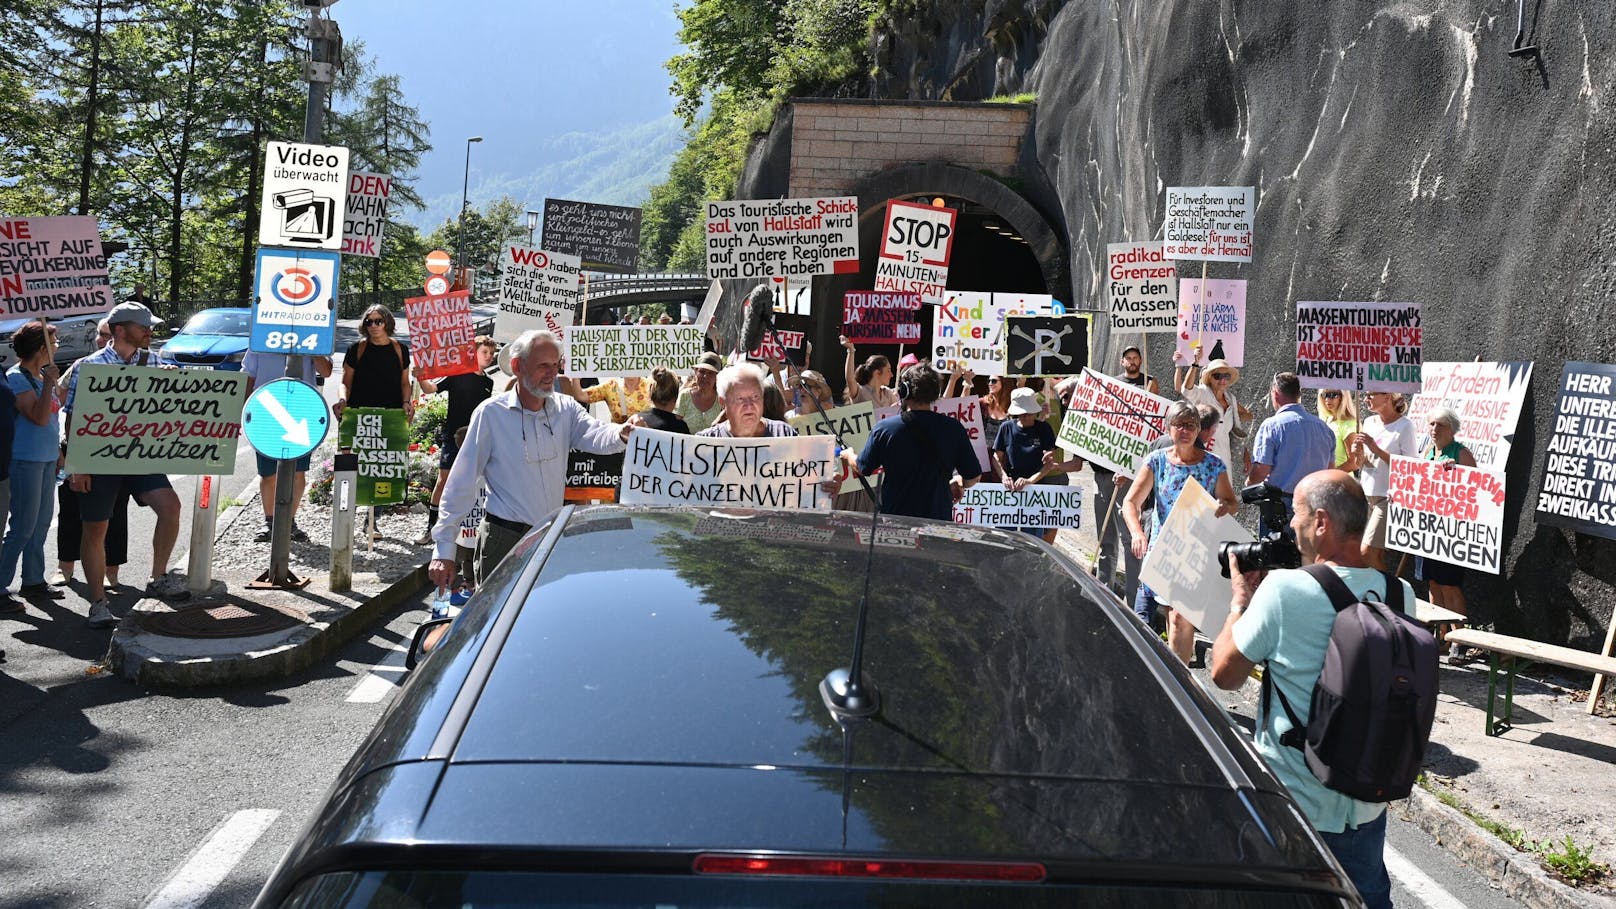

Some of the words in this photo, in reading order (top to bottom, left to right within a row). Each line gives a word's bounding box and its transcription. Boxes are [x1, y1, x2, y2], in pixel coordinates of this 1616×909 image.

[277, 146, 339, 168] Video
[273, 166, 339, 182] überwacht
[350, 174, 391, 198] DEN
[1184, 192, 1224, 205] Investoren
[1227, 193, 1245, 205] und
[709, 204, 735, 218] Das
[740, 201, 812, 218] touristische
[816, 200, 858, 215] Schick-
[1168, 205, 1246, 218] Geschäftemacher
[708, 218, 731, 233] sal
[734, 221, 759, 233] von
[764, 215, 822, 232] Hallstatt
[825, 214, 854, 229] wird
[889, 217, 951, 249] STOP
[1179, 217, 1216, 230] Hallstatt
[1216, 222, 1231, 230] nur
[1233, 219, 1249, 230] ein
[709, 234, 742, 249] auch
[748, 232, 843, 250] Auswirkungen
[1209, 230, 1221, 244] für
[1240, 231, 1252, 244] ist
[0, 241, 50, 257] SICHT
[60, 240, 95, 255] AUF
[710, 248, 734, 264] auf
[740, 248, 787, 261] andere
[793, 245, 856, 262] Regionen
[1110, 246, 1175, 264] radikal
[1167, 245, 1175, 253] es
[1178, 242, 1198, 255] aber
[1201, 242, 1215, 255] die
[1218, 243, 1252, 257] Heimat
[511, 247, 548, 269] WO
[550, 258, 582, 276] haben
[710, 264, 738, 278] und
[743, 262, 774, 277] Orte
[781, 262, 825, 278] haben
[507, 264, 527, 278] sich
[530, 268, 544, 281] die
[879, 262, 938, 282] MINUTEN
[1110, 265, 1176, 280] Grenzen
[504, 276, 534, 290] steckt
[536, 281, 549, 294] die
[876, 276, 947, 299] HALLSTATT
[1111, 281, 1133, 296] für
[1140, 280, 1168, 295] den
[3, 291, 107, 314] TOURISMUS
[406, 297, 469, 318] WARUM
[503, 287, 576, 311] Weltkulturerbe
[844, 293, 921, 310] TOURISMUS
[1211, 302, 1236, 314] LÄRM
[260, 311, 312, 321] HITRADIO
[500, 301, 542, 318] schützen
[843, 308, 861, 325] JA
[939, 296, 983, 323] Kind
[1297, 308, 1420, 328] MASSENTOURISMUS
[408, 316, 472, 335] SCHAUEN
[938, 320, 954, 338] in
[959, 320, 991, 339] der
[1111, 313, 1178, 328] tourismus
[1210, 323, 1238, 333] NICHTS
[265, 331, 319, 350] 89.4
[410, 335, 430, 352] SO
[436, 327, 474, 346] VIELE
[571, 329, 622, 343] HALLSTATT
[628, 329, 641, 343] IST
[646, 328, 669, 342] DER
[896, 323, 921, 339] NEIN
[1298, 326, 1316, 342] IST
[1317, 326, 1422, 347] SCHONUNGSLOSE
[414, 348, 462, 368] WEG
[571, 343, 599, 357] BOTE
[605, 343, 626, 356] DER
[750, 345, 785, 361] UNS
[1297, 343, 1390, 363] AUSBEUTUNG
[1395, 347, 1421, 365] VON
[571, 357, 587, 371] EN
[88, 368, 138, 393] wir
[148, 371, 237, 396] müssen
[1296, 360, 1353, 379] MENSCH
[1356, 367, 1364, 391] UND
[1368, 363, 1422, 383] NATUR
[1424, 368, 1445, 392] wir
[1443, 364, 1501, 399] fordern
[1565, 373, 1612, 395] HERR
[1076, 384, 1094, 399] WIR
[1096, 391, 1147, 422] BRAUCHEN
[1084, 374, 1103, 391] WIR
[1105, 383, 1160, 415] BRAUCHEN
[104, 397, 221, 418] unseren
[1461, 400, 1511, 421] MASSIVE
[77, 413, 241, 439] Lebensraum
[357, 414, 383, 427] ICH
[1072, 399, 1090, 413] WIR
[1091, 407, 1143, 438] BRAUCHEN
[1555, 415, 1580, 435] DIE
[356, 425, 382, 437] BIN
[1067, 411, 1088, 430] WIR
[1089, 423, 1150, 458] BRAUCHEN
[91, 437, 221, 461] schützen
[351, 436, 388, 449] KEIN
[358, 449, 406, 463] ASSEN
[574, 458, 595, 472] mit
[633, 436, 770, 478] HALLSTATT
[1547, 453, 1588, 477] DIESE
[358, 463, 404, 478] URIST
[630, 473, 663, 495] DER
[668, 480, 754, 502] GANZEN
[1390, 473, 1415, 492] FÜR
[1419, 478, 1477, 506] BILLIGE
[1391, 459, 1430, 478] KEINE
[1432, 464, 1466, 484] ZEIT
[1467, 470, 1505, 507] MEHR
[1543, 472, 1596, 499] DIREKT
[1392, 491, 1480, 523] AUSREDEN
[1390, 505, 1414, 529] WIR
[1419, 512, 1497, 546] BRAUCHEN
